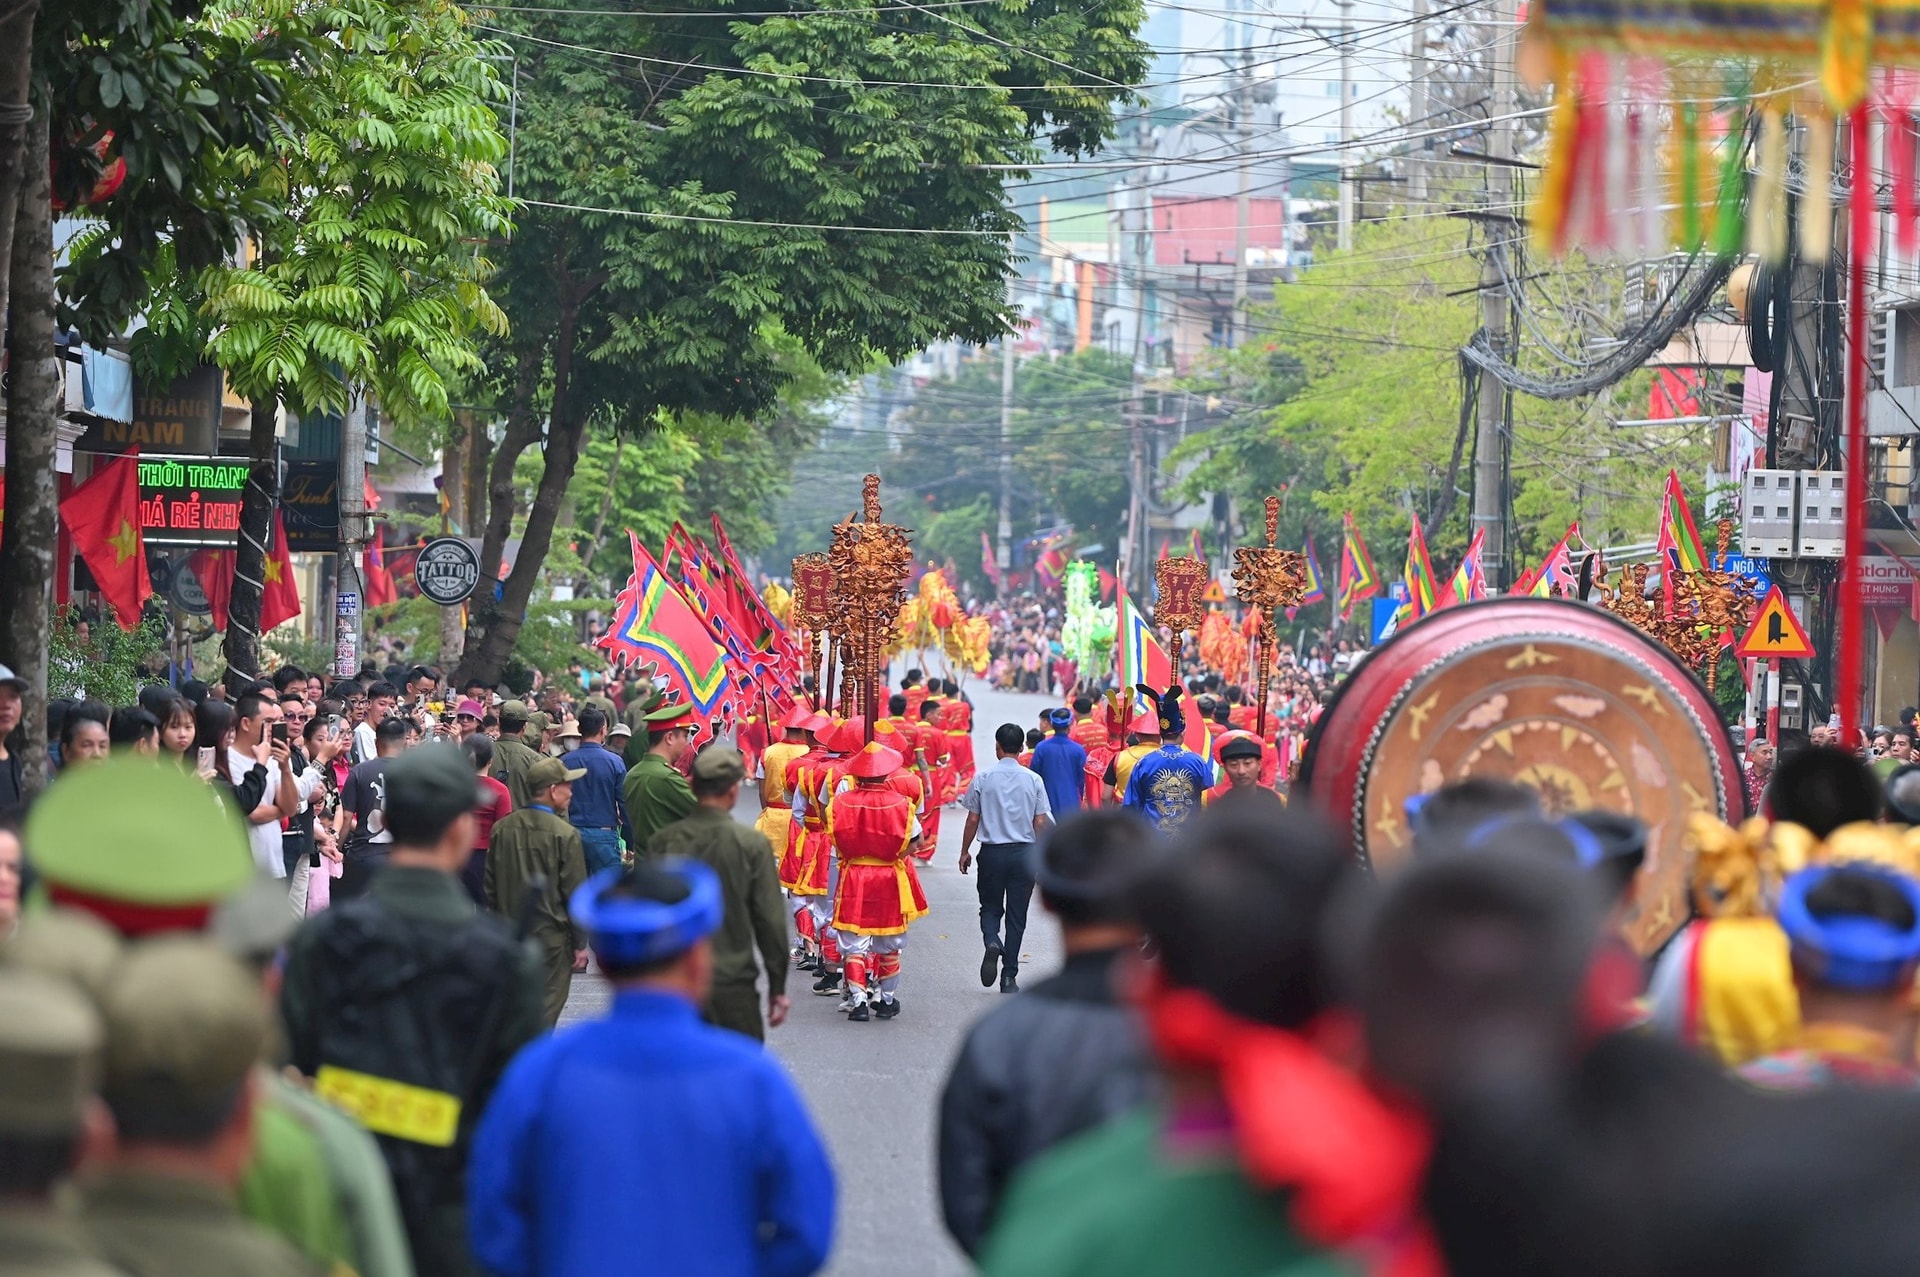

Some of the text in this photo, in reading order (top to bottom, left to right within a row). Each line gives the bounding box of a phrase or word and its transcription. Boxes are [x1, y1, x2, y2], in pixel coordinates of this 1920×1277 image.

[103, 420, 184, 445] NAM
[138, 460, 184, 487] THỜI
[140, 494, 166, 528] IÁ
[170, 491, 200, 529] RẺ
[418, 560, 477, 585] TATTOO
[1733, 558, 1754, 574] NGÕ
